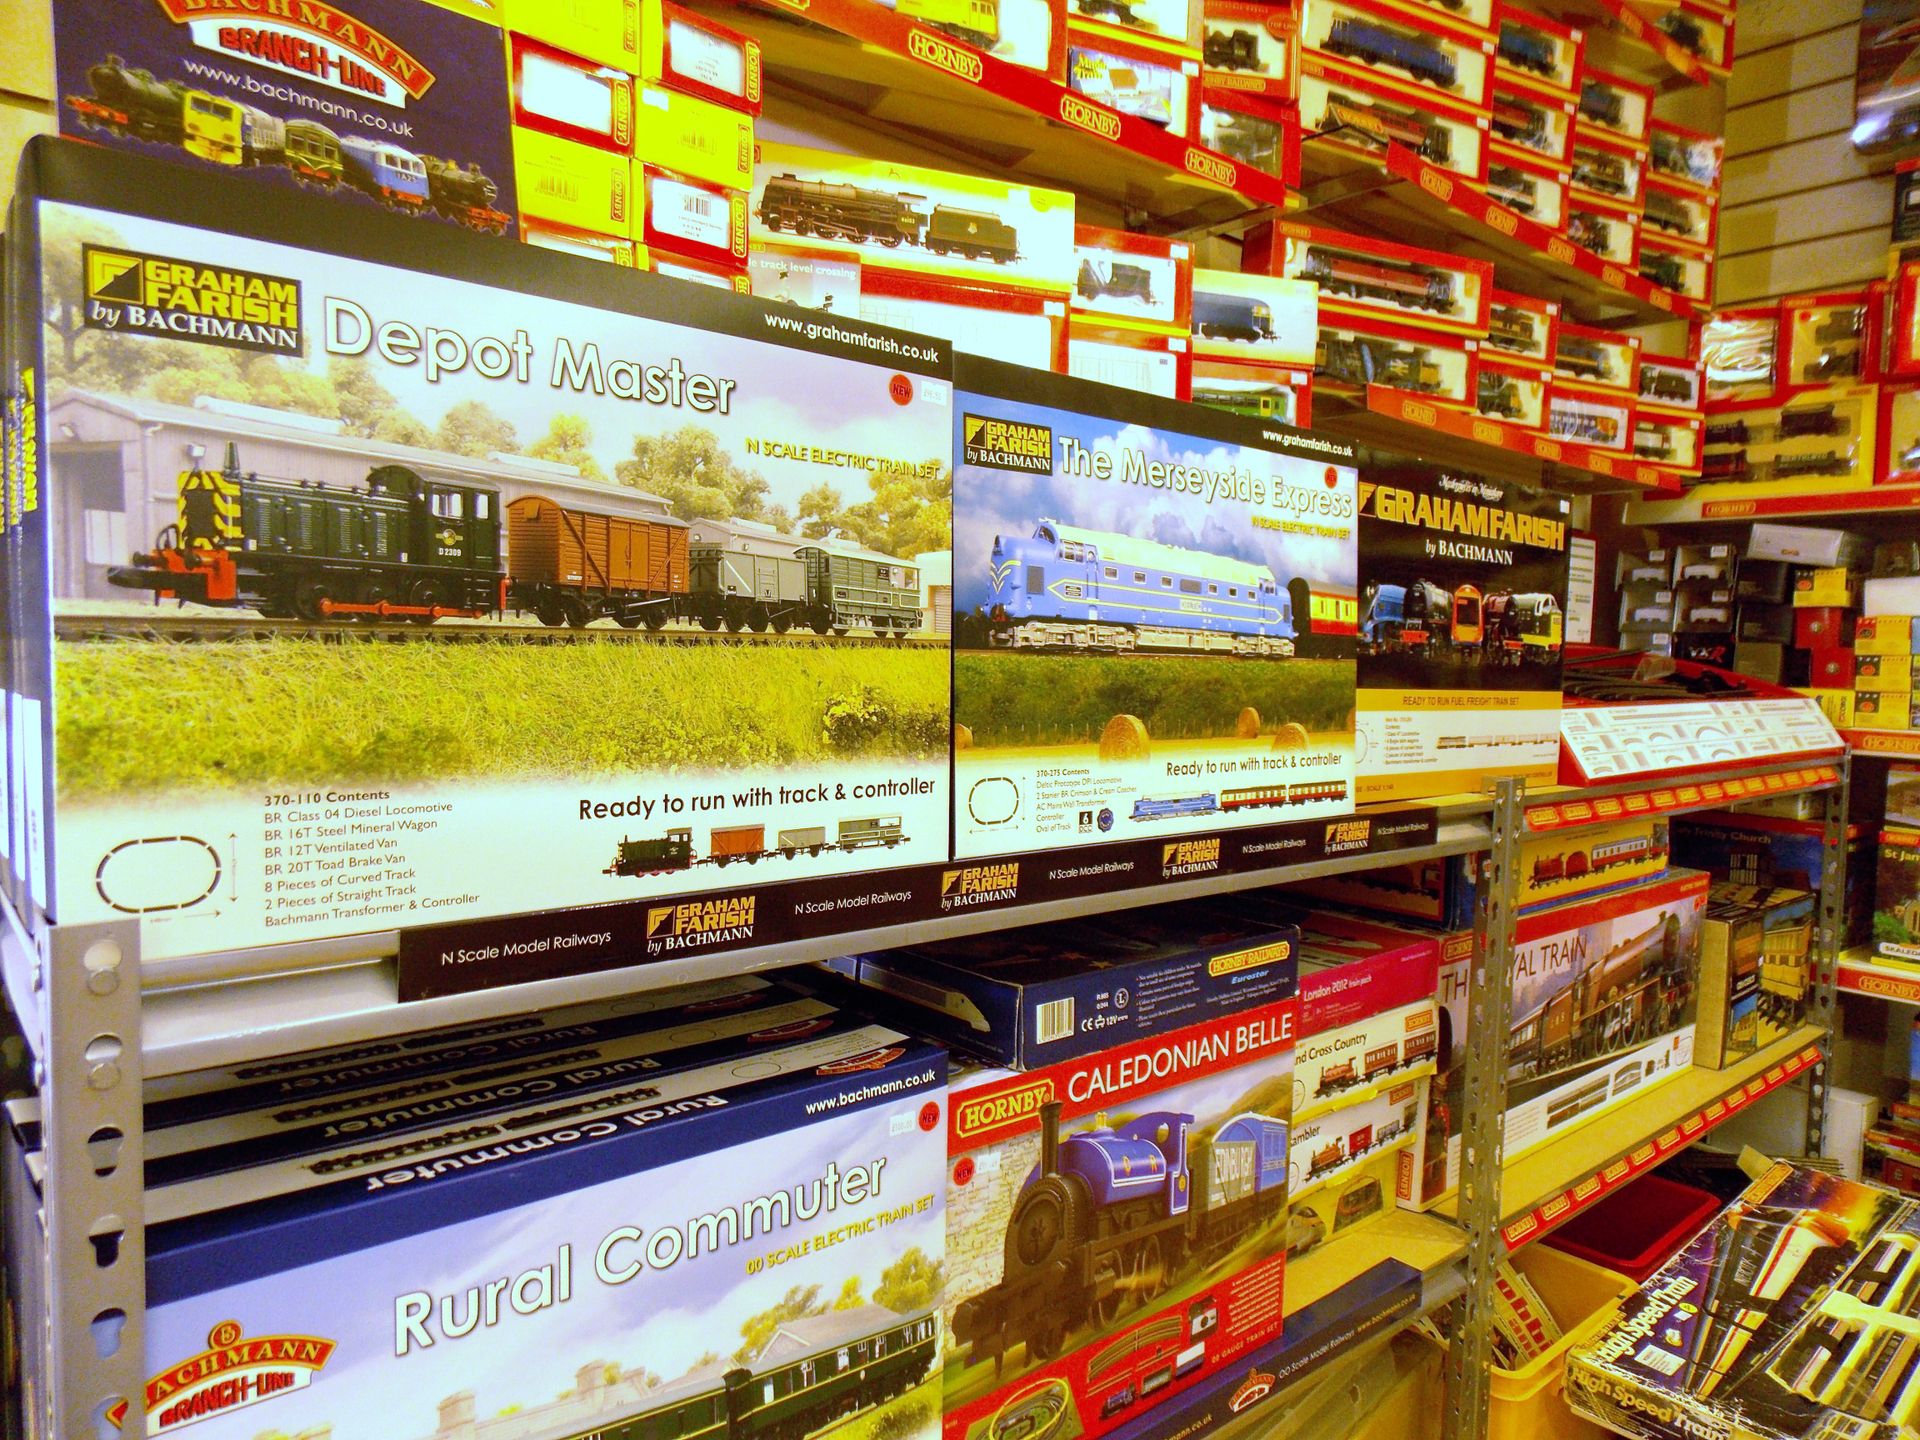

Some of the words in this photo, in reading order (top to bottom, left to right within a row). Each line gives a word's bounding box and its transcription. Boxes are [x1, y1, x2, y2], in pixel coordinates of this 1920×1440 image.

[219, 27, 386, 97] BRANCH-LINE
[912, 36, 979, 78] HORNBY
[747, 44, 760, 101] HORNBY
[184, 59, 414, 138] www.bachmann.co.uk
[616, 82, 630, 143] HORNBY
[1065, 100, 1117, 136] HORNBY
[739, 126, 750, 172] HORNBY
[1189, 152, 1234, 183] HORNBY
[612, 169, 624, 221] HORNBY
[733, 200, 746, 255] HORNBY
[144, 260, 297, 305] GRAHAM
[760, 259, 788, 272] track
[790, 262, 813, 274] level
[815, 264, 857, 281] crossing
[145, 280, 298, 329] FARISH
[91, 301, 121, 330] by
[128, 305, 299, 350] BACHMANN
[765, 313, 939, 363] www.grahamfarish.co.uk
[324, 296, 534, 382] Depot
[551, 337, 737, 415] Master
[893, 383, 912, 397] NEW
[986, 421, 1050, 442] GRAHAM
[745, 437, 759, 453] N
[764, 441, 808, 462] SCALE
[812, 447, 875, 471] ELECTRIC
[876, 459, 917, 475] TRAIN
[919, 464, 940, 480] SET
[967, 448, 978, 464] by
[980, 449, 1051, 471] BACHMANN
[986, 434, 1050, 458] FARISH
[1057, 436, 1113, 479] The
[1121, 448, 1266, 504] Merseyside
[1271, 475, 1352, 518] Express
[1711, 504, 1751, 514] HORNBY
[1425, 539, 1437, 558] by
[1438, 540, 1514, 566] BACHMANN
[1403, 696, 1427, 706] READY
[1428, 696, 1436, 706] TO
[1437, 696, 1450, 706] RUN
[1451, 696, 1465, 706] FUEL
[1467, 696, 1492, 706] FREIGHT
[1493, 697, 1508, 706] TRAIN
[1867, 736, 1920, 751] HORNBY
[1062, 768, 1090, 776] Contents
[1167, 762, 1203, 778] Ready
[1206, 760, 1217, 774] to
[1220, 760, 1237, 773] run
[1240, 757, 1260, 771] with
[1263, 755, 1288, 769] track
[1291, 755, 1297, 768] &
[1300, 753, 1342, 767] controller
[264, 793, 322, 807] 370-110
[326, 790, 391, 804] Contents
[264, 812, 283, 824] BR
[288, 809, 320, 823] Class
[325, 809, 340, 820] 04
[345, 804, 382, 818] Diesel
[386, 801, 454, 816] Locomotive
[579, 797, 655, 820] Ready
[664, 793, 685, 813] to
[691, 793, 725, 811] run
[732, 787, 773, 809] with
[779, 783, 830, 804] track
[834, 783, 847, 800] &
[853, 778, 936, 799] controller
[264, 829, 283, 841] BR
[288, 827, 311, 839] 16T
[316, 824, 347, 837] Steel
[351, 821, 396, 835] Mineral
[398, 819, 438, 834] Wagon
[1036, 813, 1065, 822] Controller
[1036, 825, 1049, 834] Oval
[1050, 824, 1057, 832] of
[1057, 822, 1071, 831] Track
[264, 847, 283, 858] BR
[288, 845, 311, 856] 12T
[315, 840, 375, 854] Ventilated
[376, 838, 398, 849] Van
[1730, 831, 1772, 845] Church
[264, 864, 283, 876] BR
[288, 861, 312, 873] 20T
[315, 858, 345, 871] Toad
[349, 856, 383, 868] Brake
[385, 854, 406, 865] Van
[963, 863, 1019, 880] GRAHAM
[264, 882, 273, 893] 8
[278, 879, 316, 892] Pieces
[321, 875, 334, 887] of
[337, 872, 382, 885] Curved
[385, 868, 416, 881] Track
[962, 874, 1018, 894] FARISH
[264, 899, 273, 910] 2
[278, 896, 316, 909] Pieces
[321, 892, 334, 904] of
[337, 888, 383, 902] Straight
[385, 885, 417, 897] Track
[264, 911, 330, 927] Bachmann
[332, 903, 405, 918] Transformer
[408, 900, 418, 910] &
[422, 894, 480, 909] Controller
[676, 896, 756, 917] GRAHAM
[795, 903, 803, 915] N
[806, 899, 834, 914] Scale
[837, 894, 870, 910] Model
[871, 889, 912, 906] Railways
[941, 897, 952, 912] by
[954, 888, 1018, 908] BACHMANN
[675, 907, 755, 936] FARISH
[442, 953, 454, 965] N
[457, 946, 500, 964] Scale
[503, 937, 550, 957] Model
[553, 931, 612, 951] Railways
[647, 939, 662, 955] by
[665, 925, 754, 950] BACHMANN
[1540, 934, 1587, 972] TRAIN
[1213, 955, 1245, 973] HORNBY
[1247, 945, 1288, 965] RAILWAYS
[1231, 969, 1269, 985] Eurostar
[1303, 986, 1332, 1002] London
[1332, 978, 1348, 994] 2012
[1863, 978, 1920, 998] HORNBY
[1067, 1030, 1231, 1104] CALEDONIAN
[1236, 1013, 1293, 1058] BELLE
[1309, 1044, 1333, 1061] Cross
[1334, 1033, 1367, 1051] Country
[806, 1069, 936, 1116] www.bachmann.co.uk
[922, 1113, 938, 1124] NEW
[965, 1084, 1045, 1130] HORNBY
[366, 1119, 619, 1192] Commuter
[623, 1094, 730, 1127] Rural
[957, 1165, 973, 1178] NEW
[767, 1240, 809, 1270] SCALE
[813, 1219, 875, 1256] ELECTRIC
[877, 1204, 913, 1234] TRAIN
[915, 1194, 935, 1217] SET
[394, 1242, 571, 1358] Rural
[594, 1155, 887, 1286] Commuter
[1222, 1341, 1244, 1358] GAUGE
[1246, 1328, 1266, 1344] TRAIN
[155, 1341, 322, 1400] ACHMANN
[1571, 1366, 1612, 1397] High
[1614, 1385, 1674, 1423] Speed
